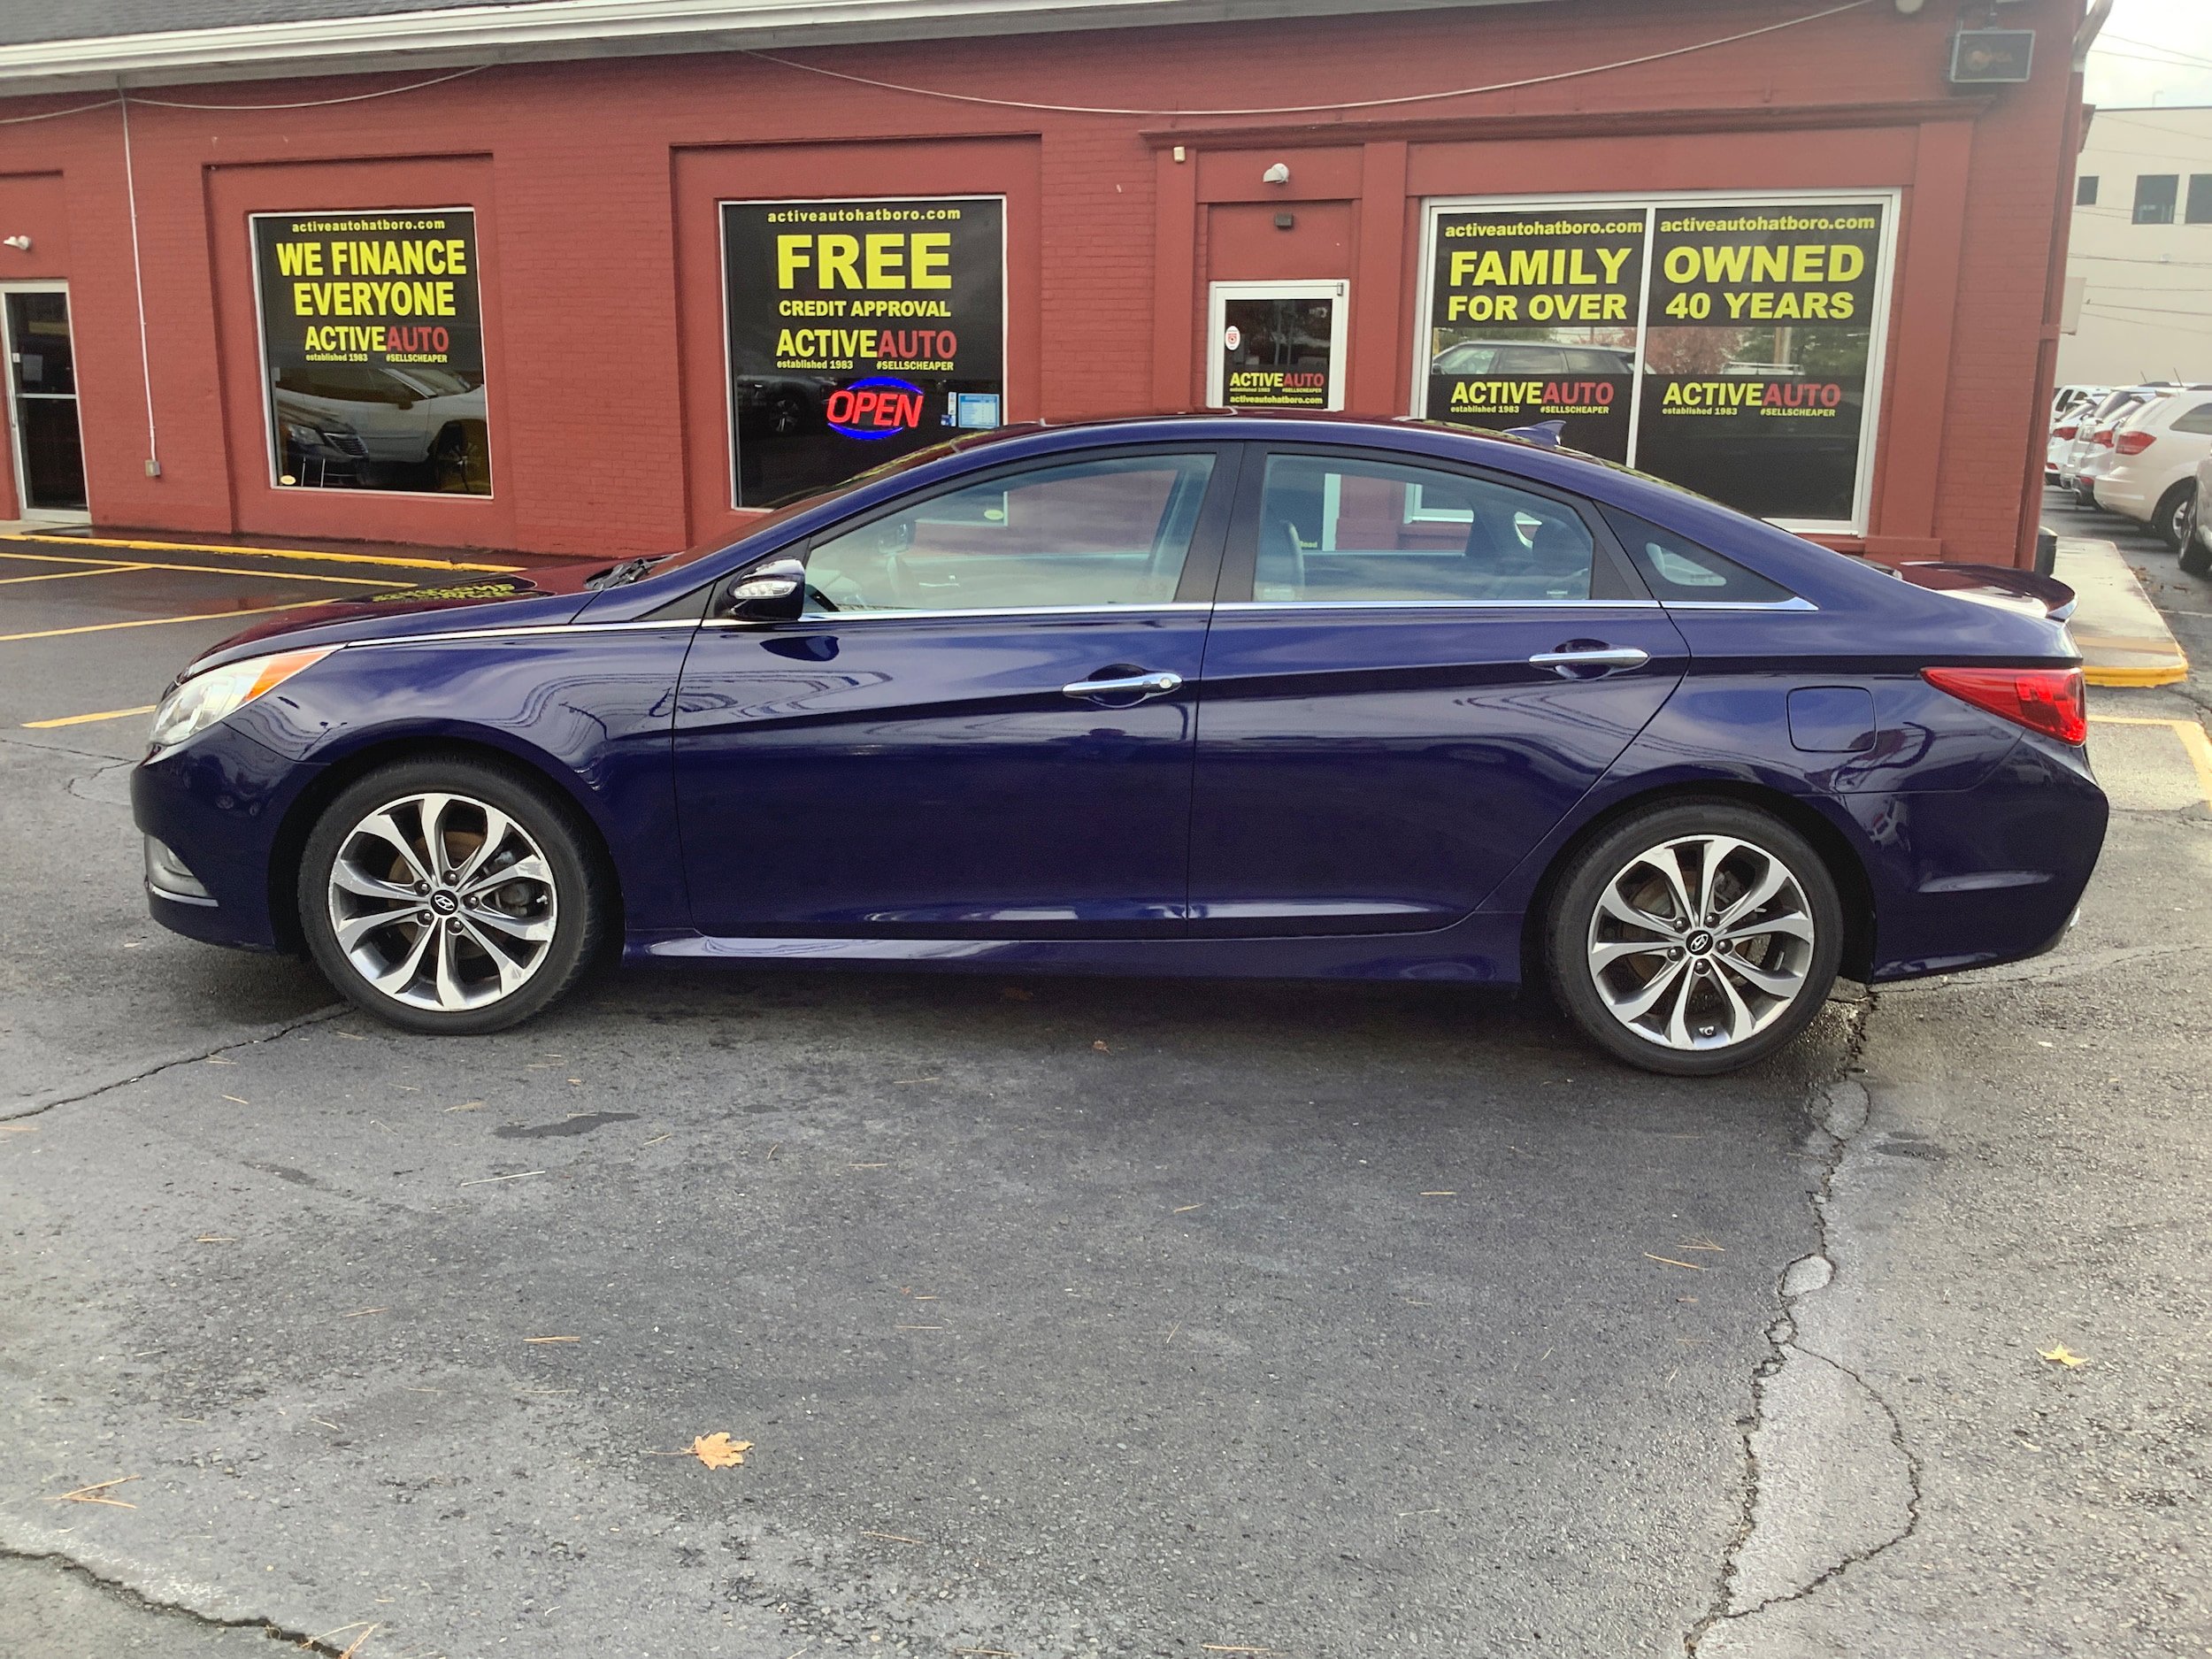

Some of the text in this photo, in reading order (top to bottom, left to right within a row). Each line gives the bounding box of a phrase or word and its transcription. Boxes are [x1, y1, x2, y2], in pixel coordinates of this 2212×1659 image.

[768, 209, 960, 222] activeautohatboro.com
[293, 219, 445, 232] activeautohatboro.com
[1445, 220, 1643, 237] activeautohatboro.com
[1660, 216, 1875, 232] activeautohatboro.com
[276, 240, 467, 276] WE FINANCE
[778, 233, 952, 289] FREE
[1663, 244, 1864, 283] OWNED
[1450, 248, 1632, 286] FAMILY
[294, 281, 457, 317] EVERYONE
[1665, 292, 1855, 319] 40 YEARS
[780, 300, 951, 317] CREDIT APPROVAL
[1448, 294, 1628, 321] FOR OVER
[305, 353, 368, 362] established 1983
[386, 354, 448, 364] #SELLSCHEAPER
[777, 359, 854, 370] established 1983
[877, 361, 954, 371] #SELLSCHEAPER
[1230, 395, 1324, 404] activeautohatboro.com
[826, 389, 924, 427] OPEN
[1498, 405, 1520, 414] 1983
[1663, 407, 1738, 416] established 1983
[1760, 408, 1836, 417] #SELLSCHEAPER
